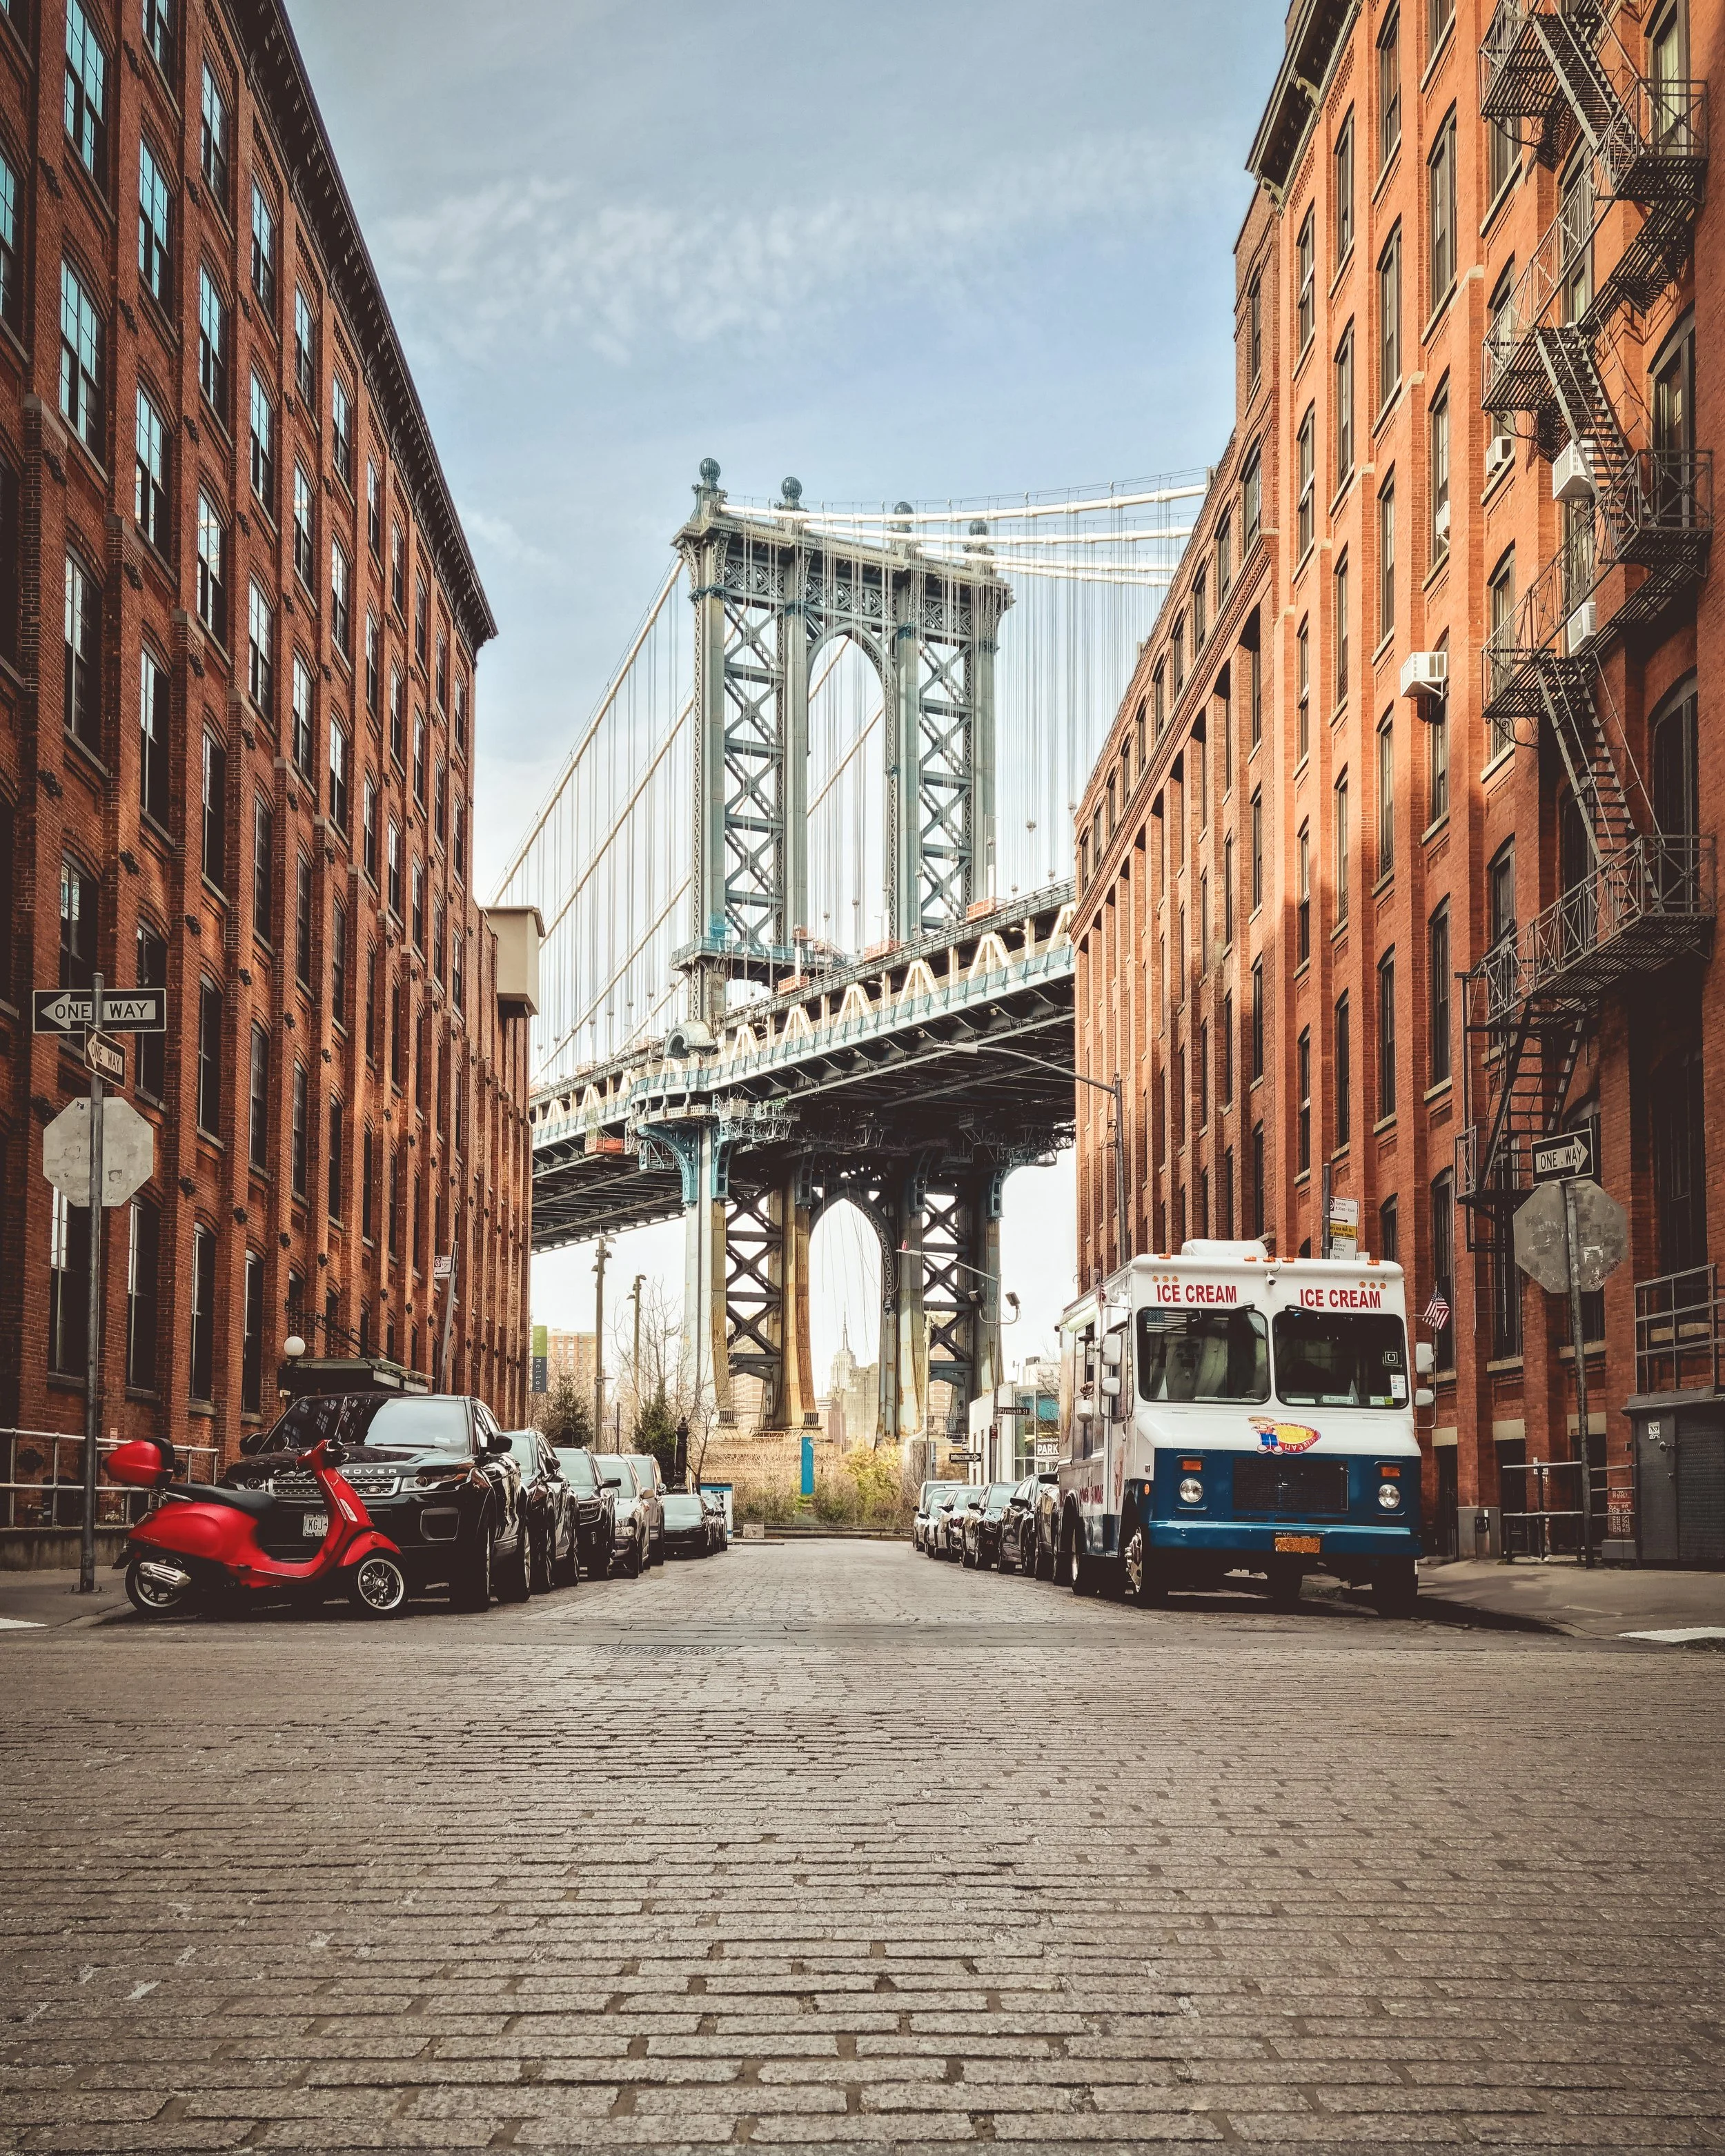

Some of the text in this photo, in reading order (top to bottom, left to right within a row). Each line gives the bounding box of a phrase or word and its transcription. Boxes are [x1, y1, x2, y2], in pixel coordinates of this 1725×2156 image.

[55, 1002, 147, 1019] ONE WAY
[91, 1042, 120, 1072] ONE WAY
[1541, 1145, 1582, 1170] ONE WAY
[1156, 1284, 1237, 1303] ICE CREAM
[1299, 1289, 1381, 1309] ICE CREAM
[1037, 1444, 1058, 1454] PARK
[308, 1519, 323, 1530] KGJ
